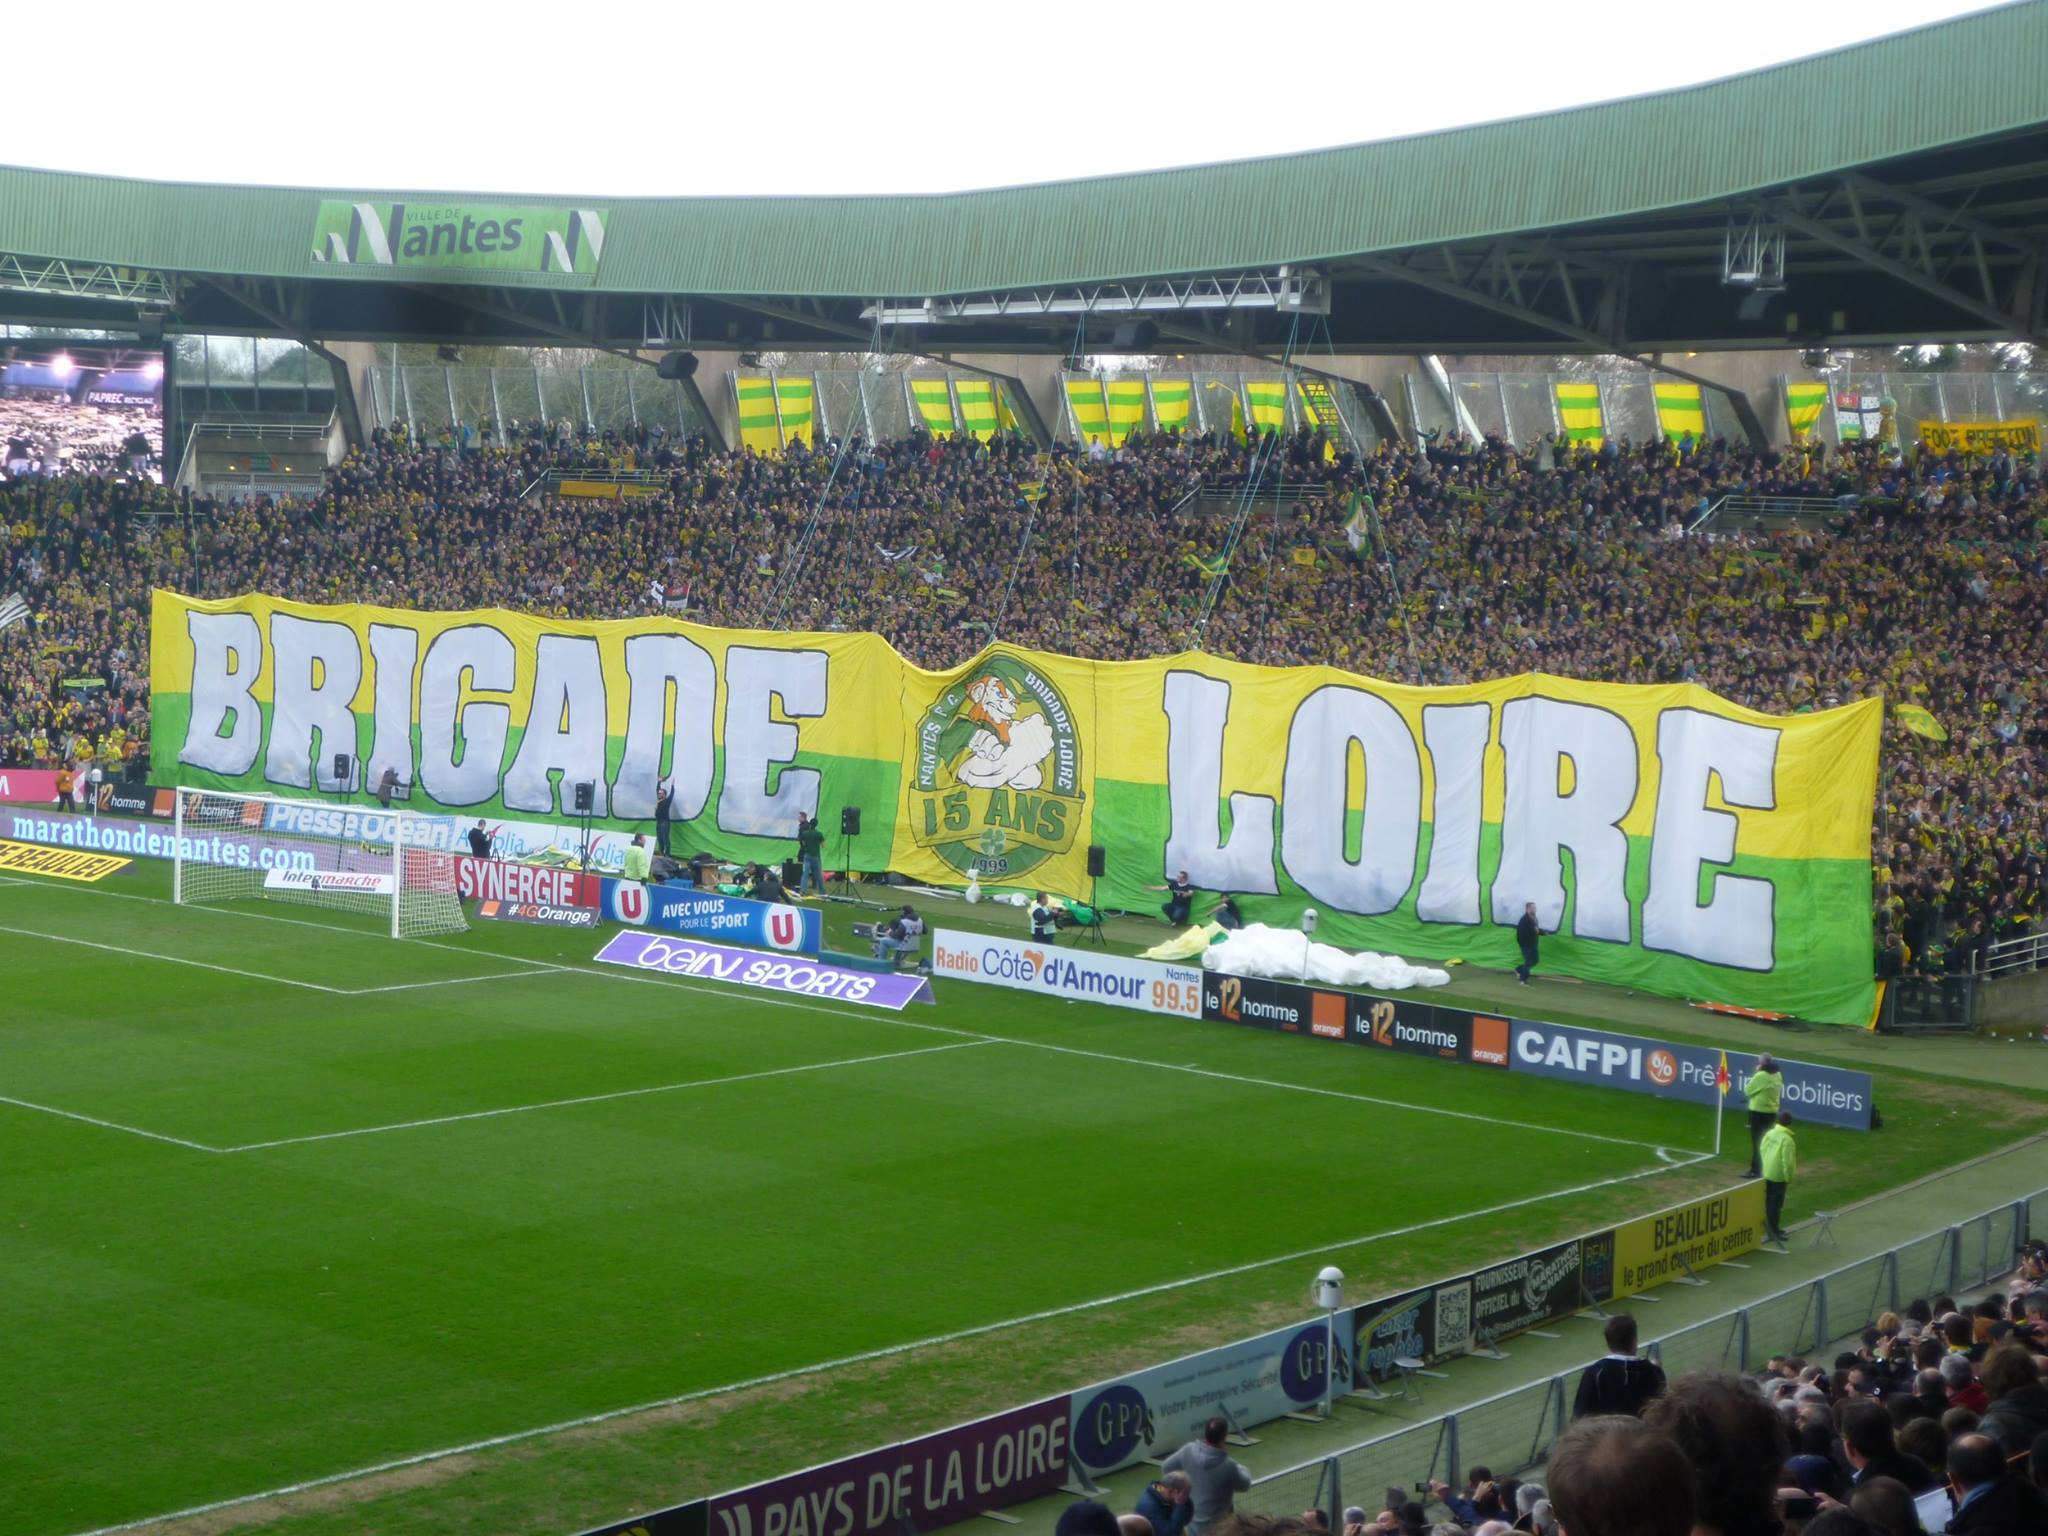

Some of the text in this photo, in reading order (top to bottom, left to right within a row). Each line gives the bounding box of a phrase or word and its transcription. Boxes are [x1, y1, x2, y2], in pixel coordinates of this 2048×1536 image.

[407, 208, 461, 222] VILLE DE
[1024, 671, 1074, 790] BRIGADE LOIRE
[920, 721, 942, 786] NANTES
[111, 795, 146, 810] homme
[178, 608, 1784, 973] BRIGADE LOIRE
[922, 788, 1068, 842] 15 ANS
[459, 857, 575, 908] SYNERGIE
[970, 857, 1009, 874] 1999
[662, 900, 725, 919] AVEC VOUS
[679, 912, 750, 930] POUR LE SPORT
[743, 960, 877, 1000] SPORTS
[936, 946, 1146, 1000] Radio Côte d'Amour
[1166, 967, 1200, 984] Nantes
[1152, 980, 1200, 1014] 99.5
[1206, 977, 1299, 1023] le 12 homme
[1313, 1023, 1344, 1036] orange
[1355, 1001, 1458, 1049] le 12 homme
[1473, 1049, 1505, 1063] orange
[1516, 1030, 1863, 1113] CAFPI Prês iobiliers
[1654, 1197, 1730, 1251] BEAULIEU
[1475, 1260, 1529, 1293] FOURNISSEUR
[1532, 1241, 1579, 1290] MARATHON
[1547, 1254, 1581, 1289] NANTES
[1623, 1265, 1634, 1288] le
[1636, 1254, 1668, 1288] grand
[1707, 1236, 1720, 1257] du
[1722, 1225, 1753, 1252] centre
[1475, 1291, 1509, 1320] OFFICIEL
[763, 1415, 1067, 1536] PAYS DE LA LOIRE
